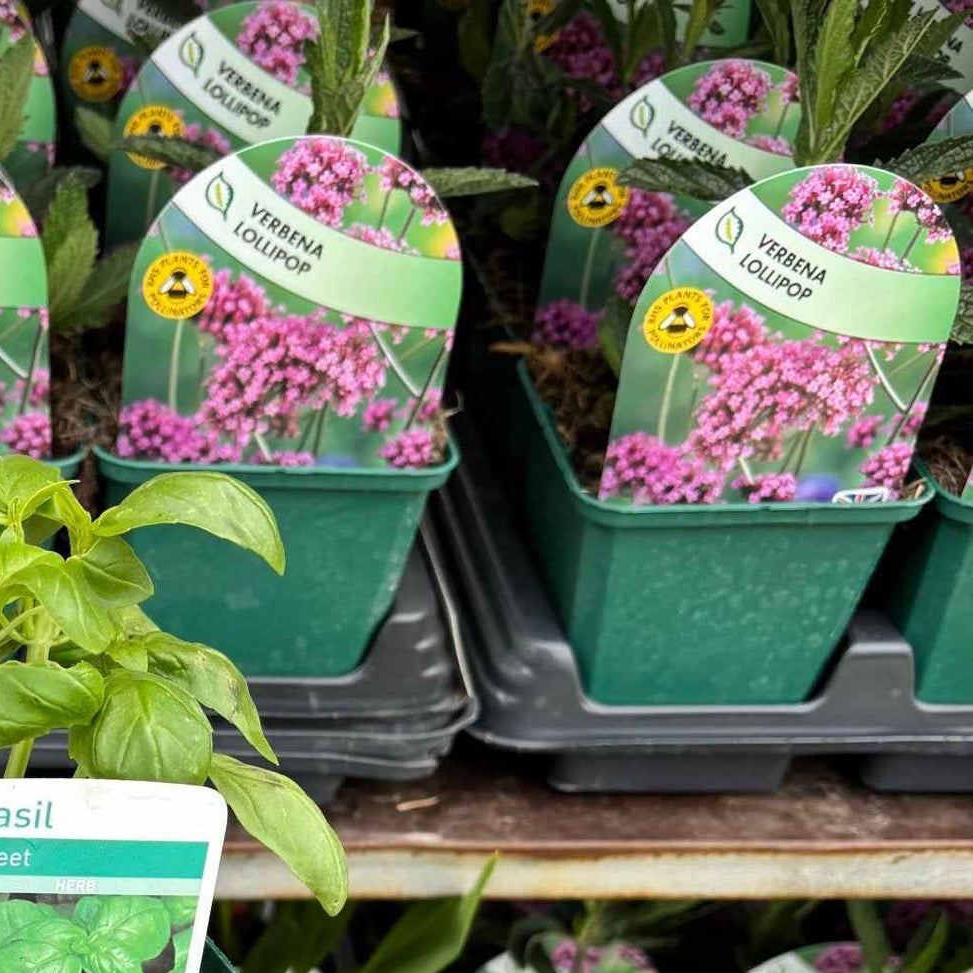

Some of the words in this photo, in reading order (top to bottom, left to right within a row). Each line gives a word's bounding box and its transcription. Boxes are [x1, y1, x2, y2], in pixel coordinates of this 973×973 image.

[203, 78, 271, 130] LOLLIPOP
[218, 59, 281, 115] VERBENA
[667, 119, 729, 166] VERBENA
[232, 220, 312, 275] LOLLIPOP
[250, 201, 324, 260] VERBENA
[738, 252, 813, 301] LOLLIPOP
[758, 232, 827, 285] VERBENA
[55, 878, 98, 892] HERB
